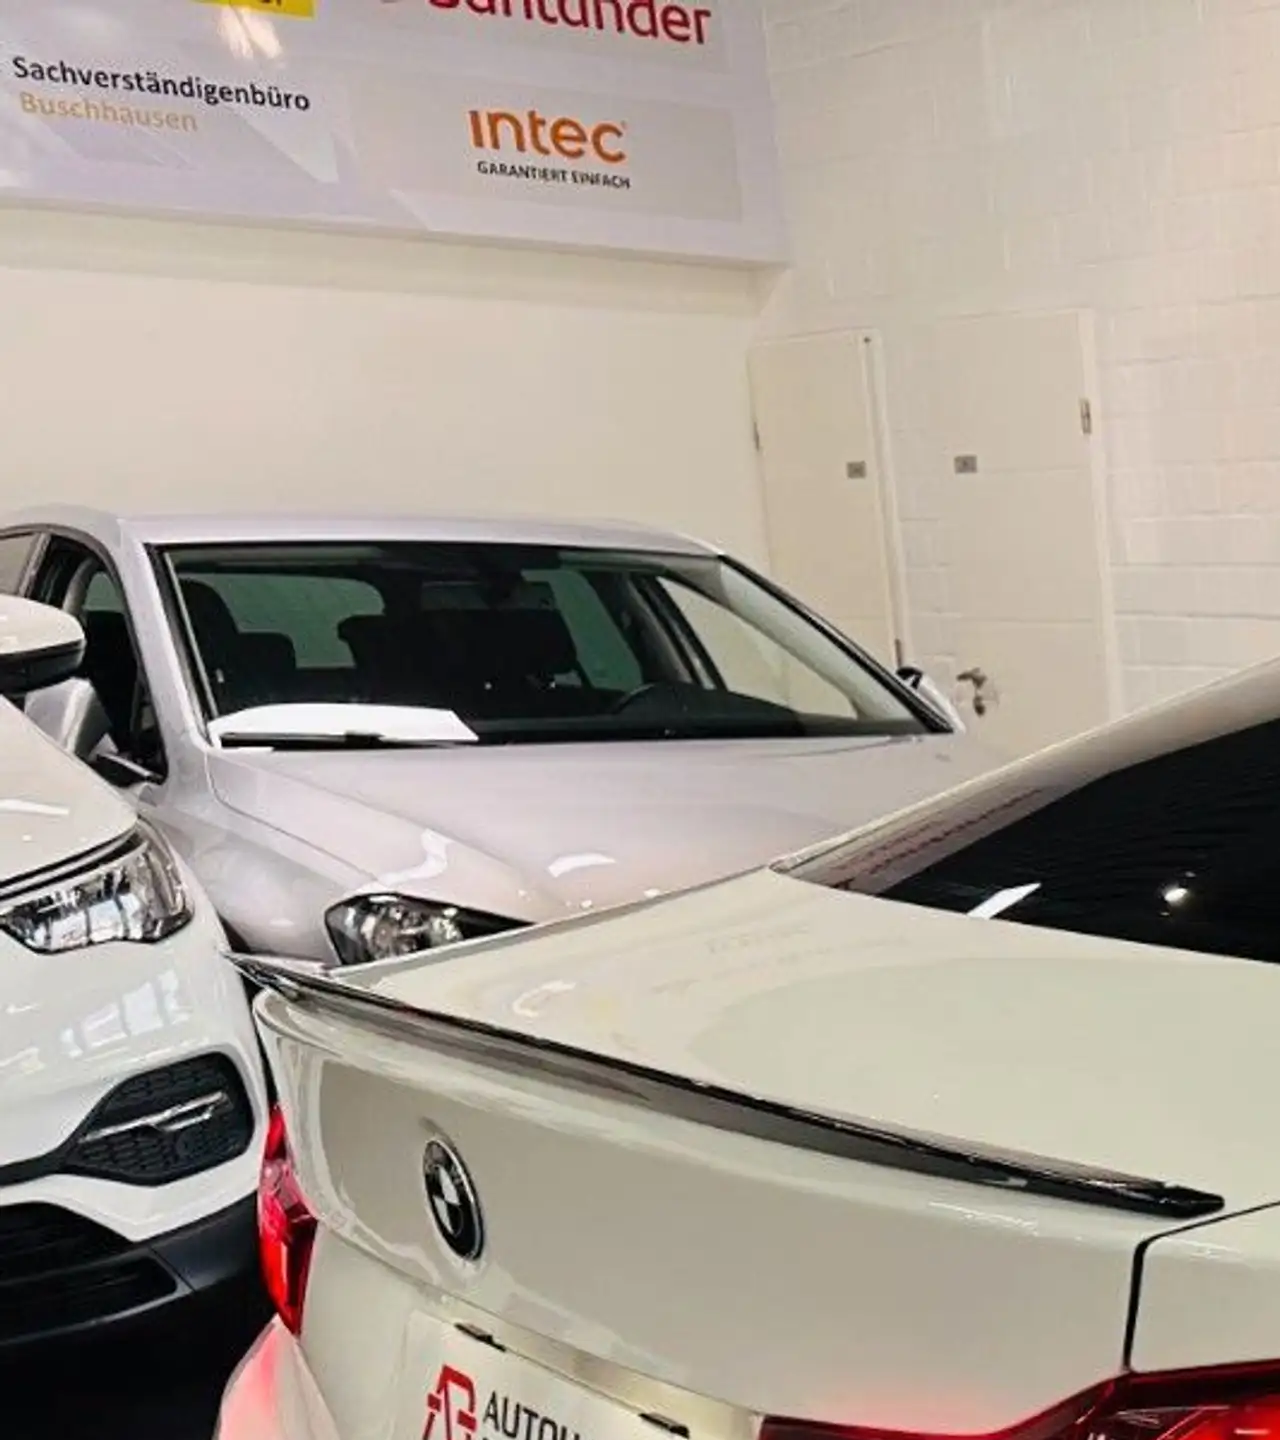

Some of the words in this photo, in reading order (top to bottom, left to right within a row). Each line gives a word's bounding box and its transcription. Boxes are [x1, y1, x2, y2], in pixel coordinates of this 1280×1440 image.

[12, 56, 311, 111] Sachverständigenbüro
[19, 91, 198, 132] Buschhausen
[477, 160, 567, 183] GARANTIERT
[571, 170, 631, 190] EINFACH
